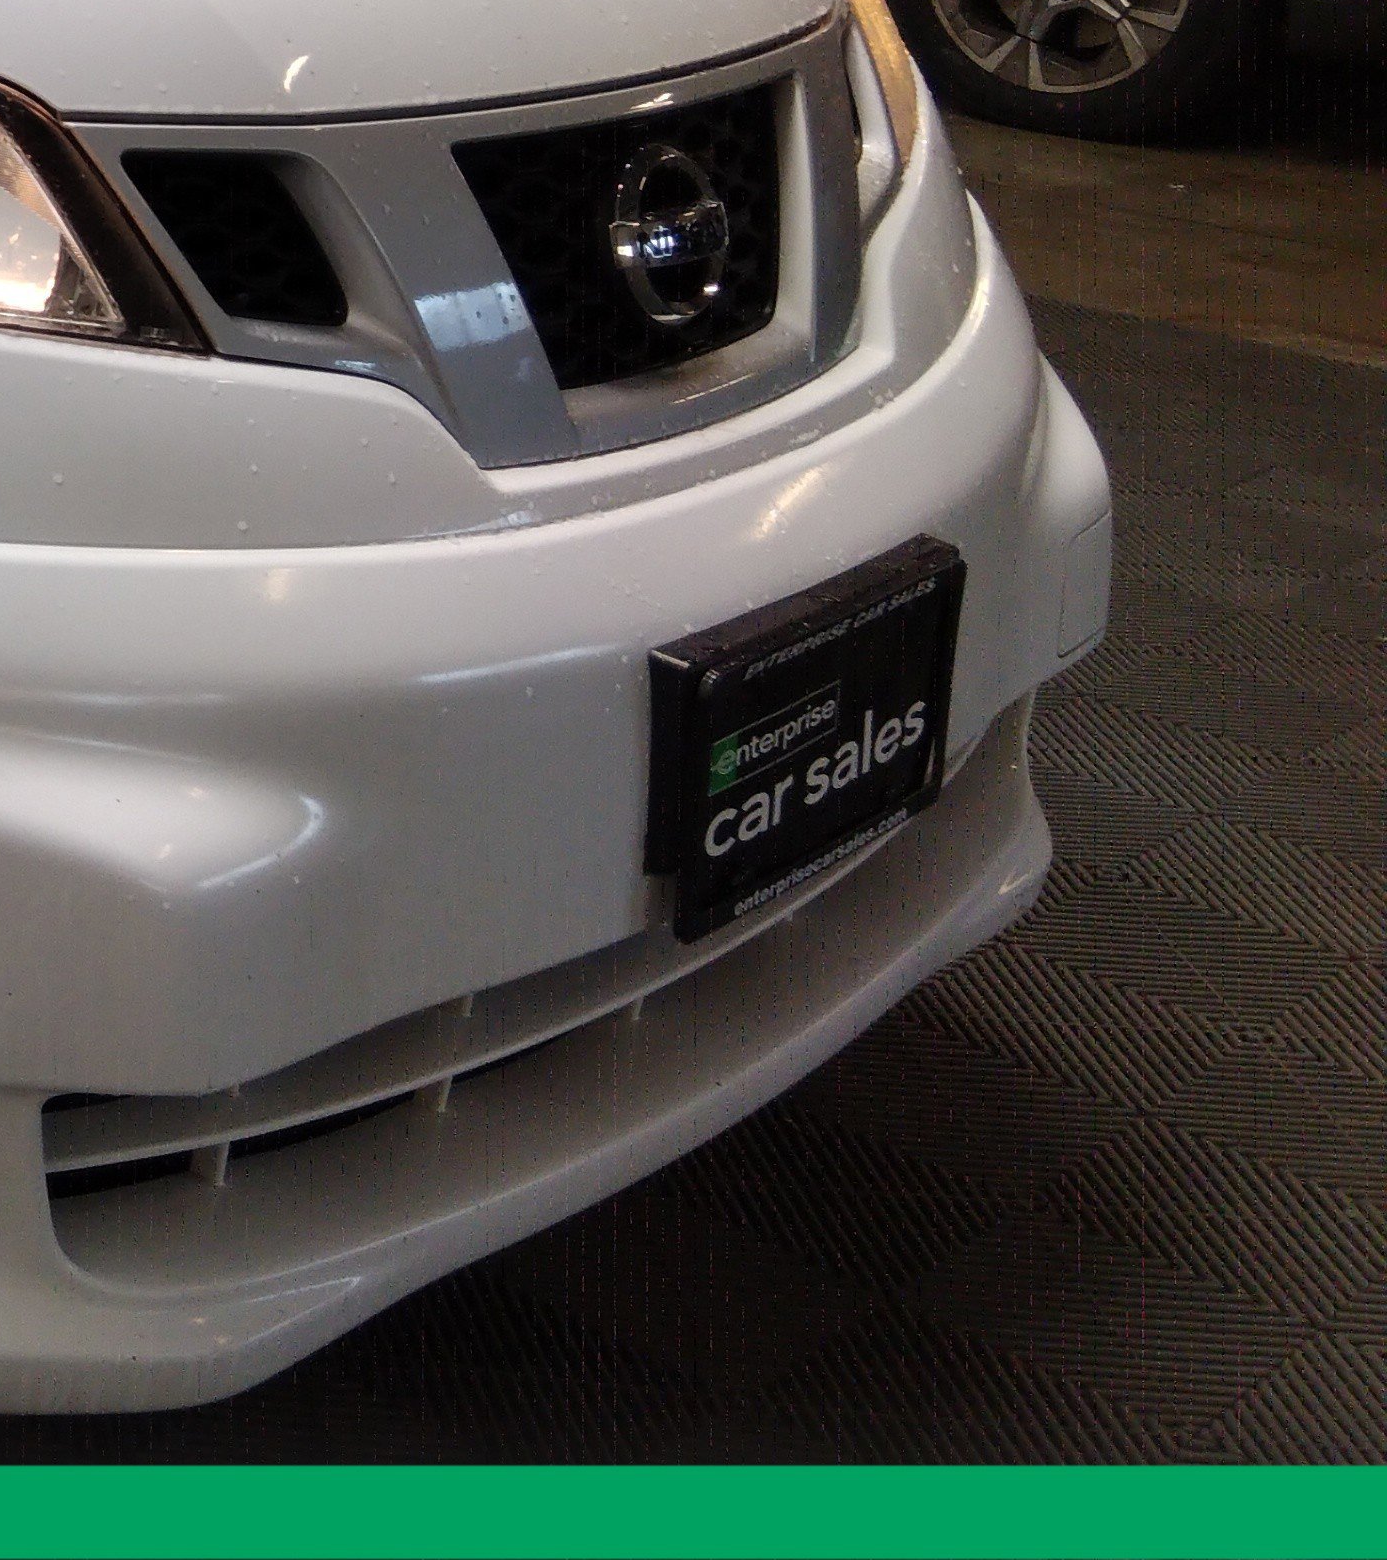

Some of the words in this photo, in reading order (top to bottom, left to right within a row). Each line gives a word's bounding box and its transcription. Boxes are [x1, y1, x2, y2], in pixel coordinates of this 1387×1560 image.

[704, 775, 795, 858] car
[803, 700, 926, 806] sales
[710, 699, 837, 776] enterprise
